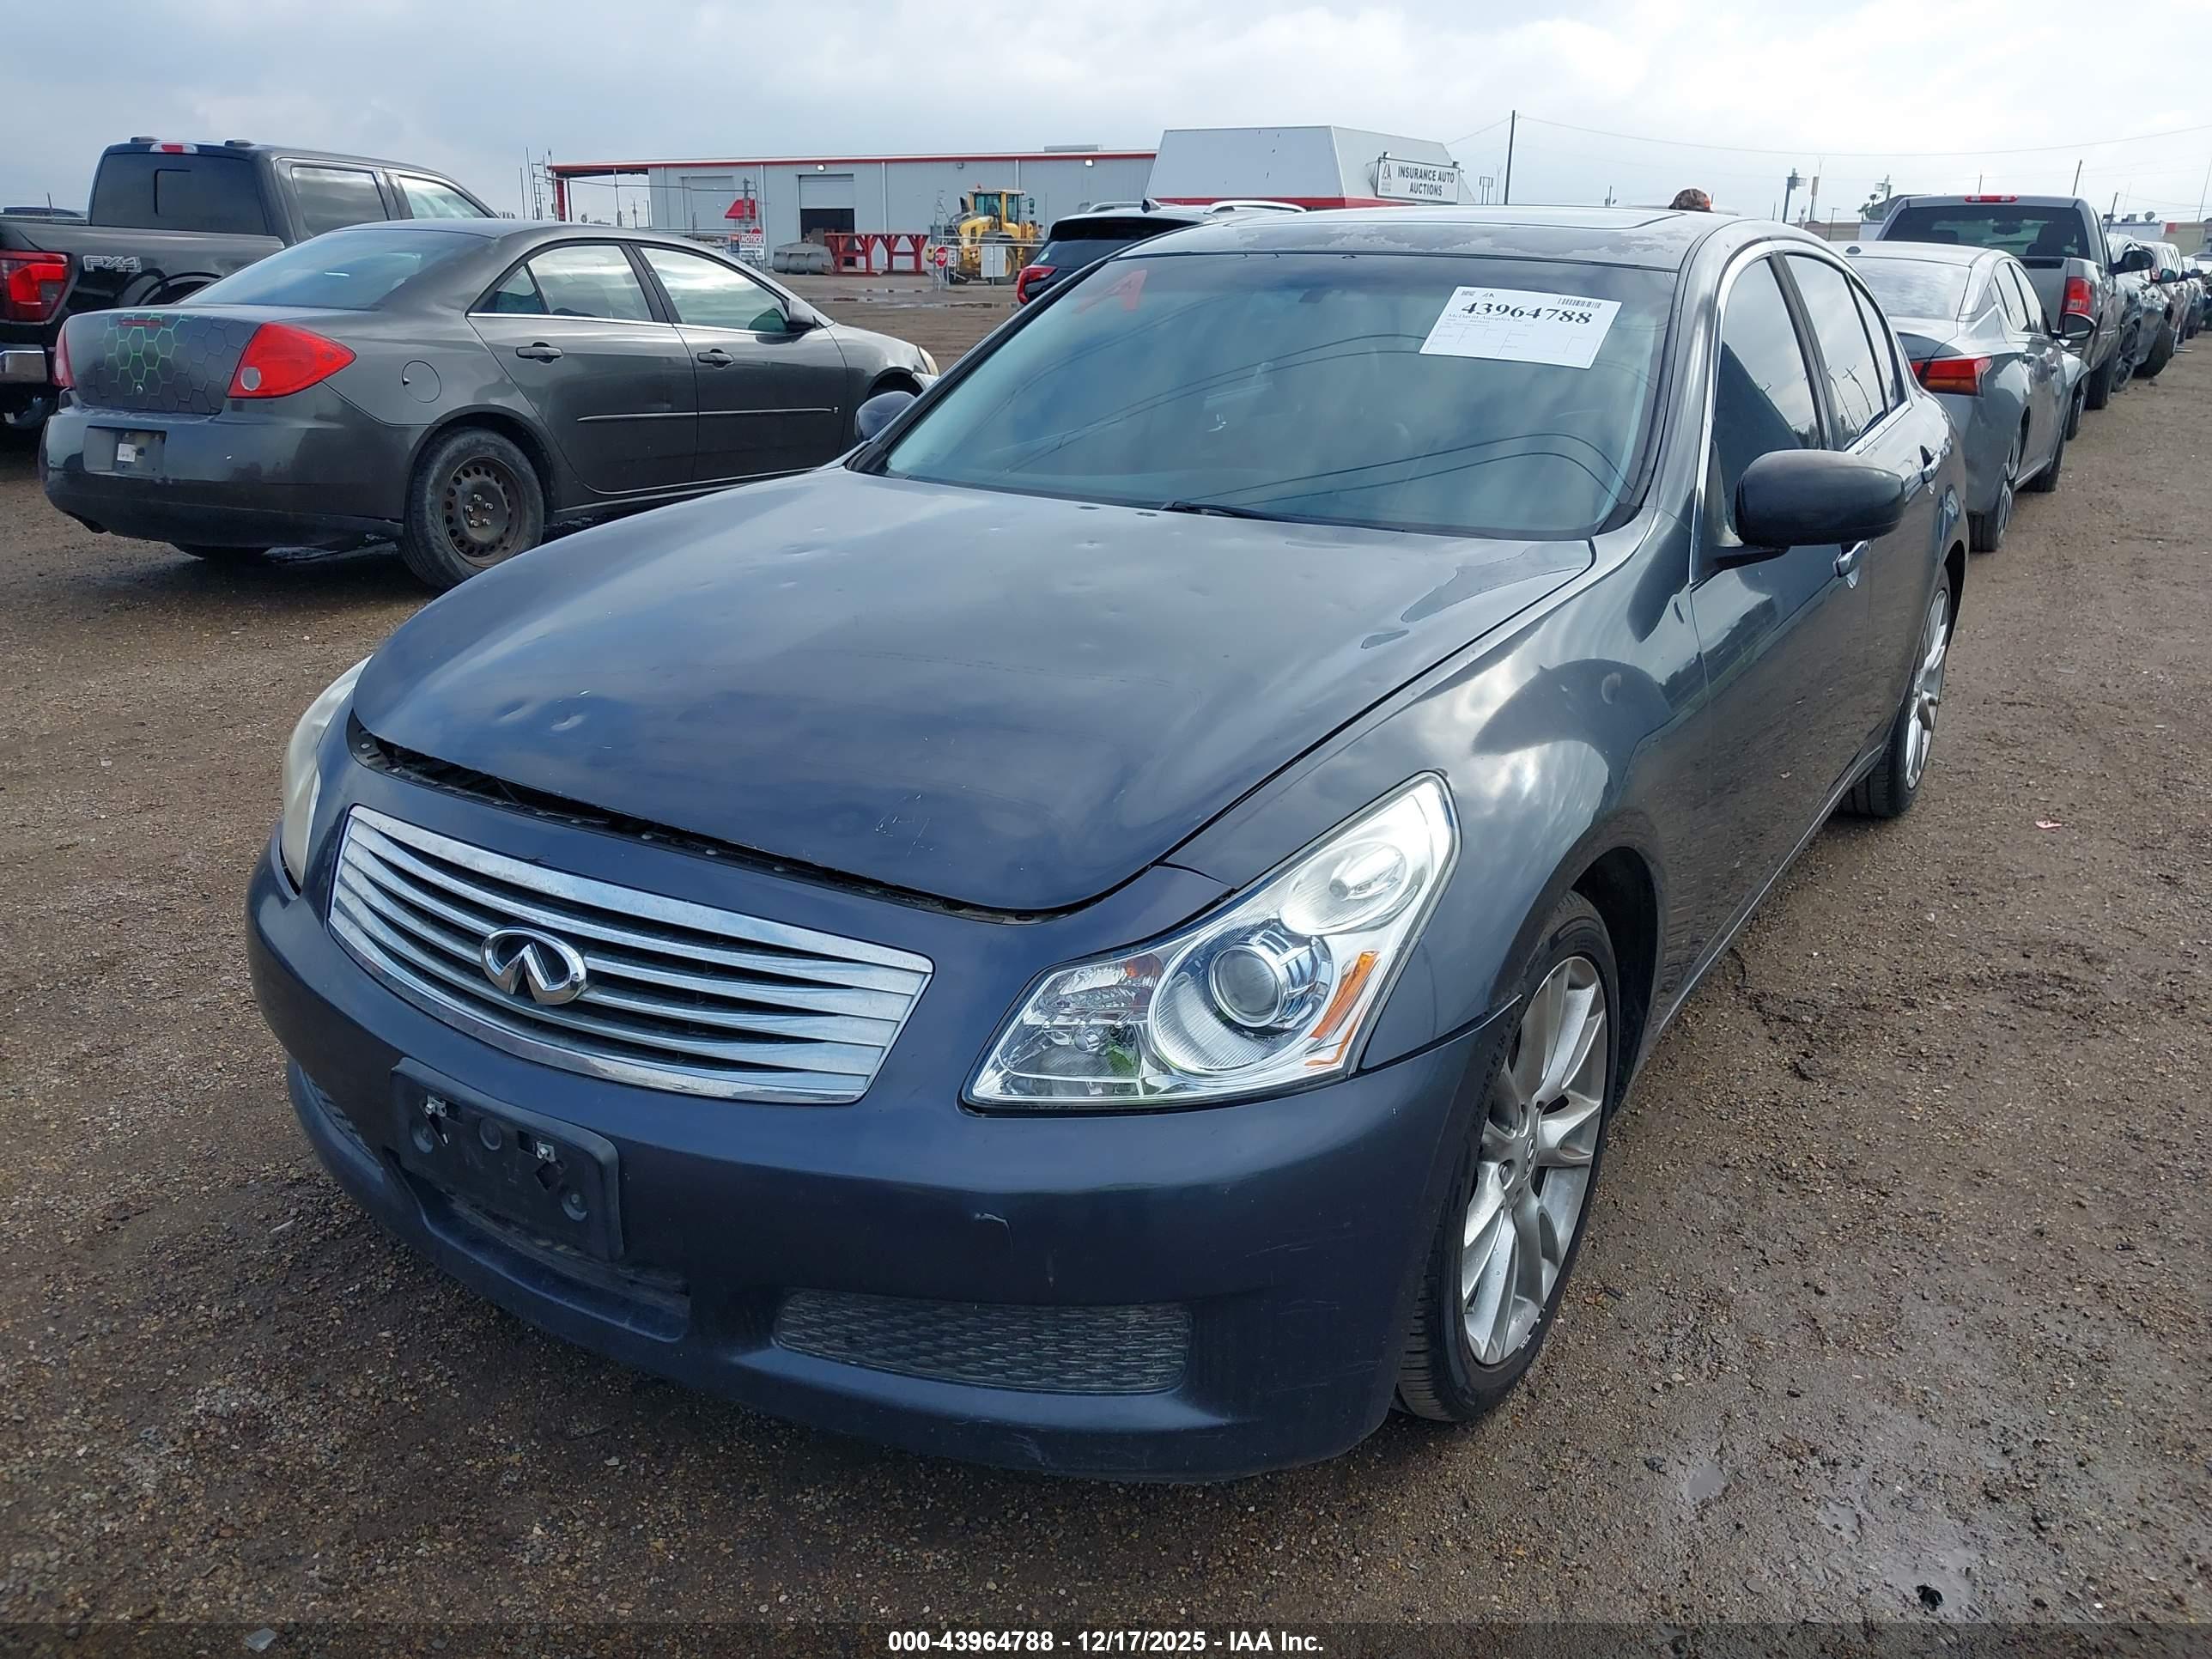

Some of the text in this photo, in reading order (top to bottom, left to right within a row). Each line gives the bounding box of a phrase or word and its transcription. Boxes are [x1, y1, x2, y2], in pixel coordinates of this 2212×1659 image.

[1398, 166, 1437, 182] INSURANCE
[1437, 171, 1455, 184] AUTO
[1409, 182, 1443, 197] AUCTIONS
[82, 255, 142, 272] FX4
[949, 257, 956, 265] 15
[1462, 302, 1592, 324] 43964788
